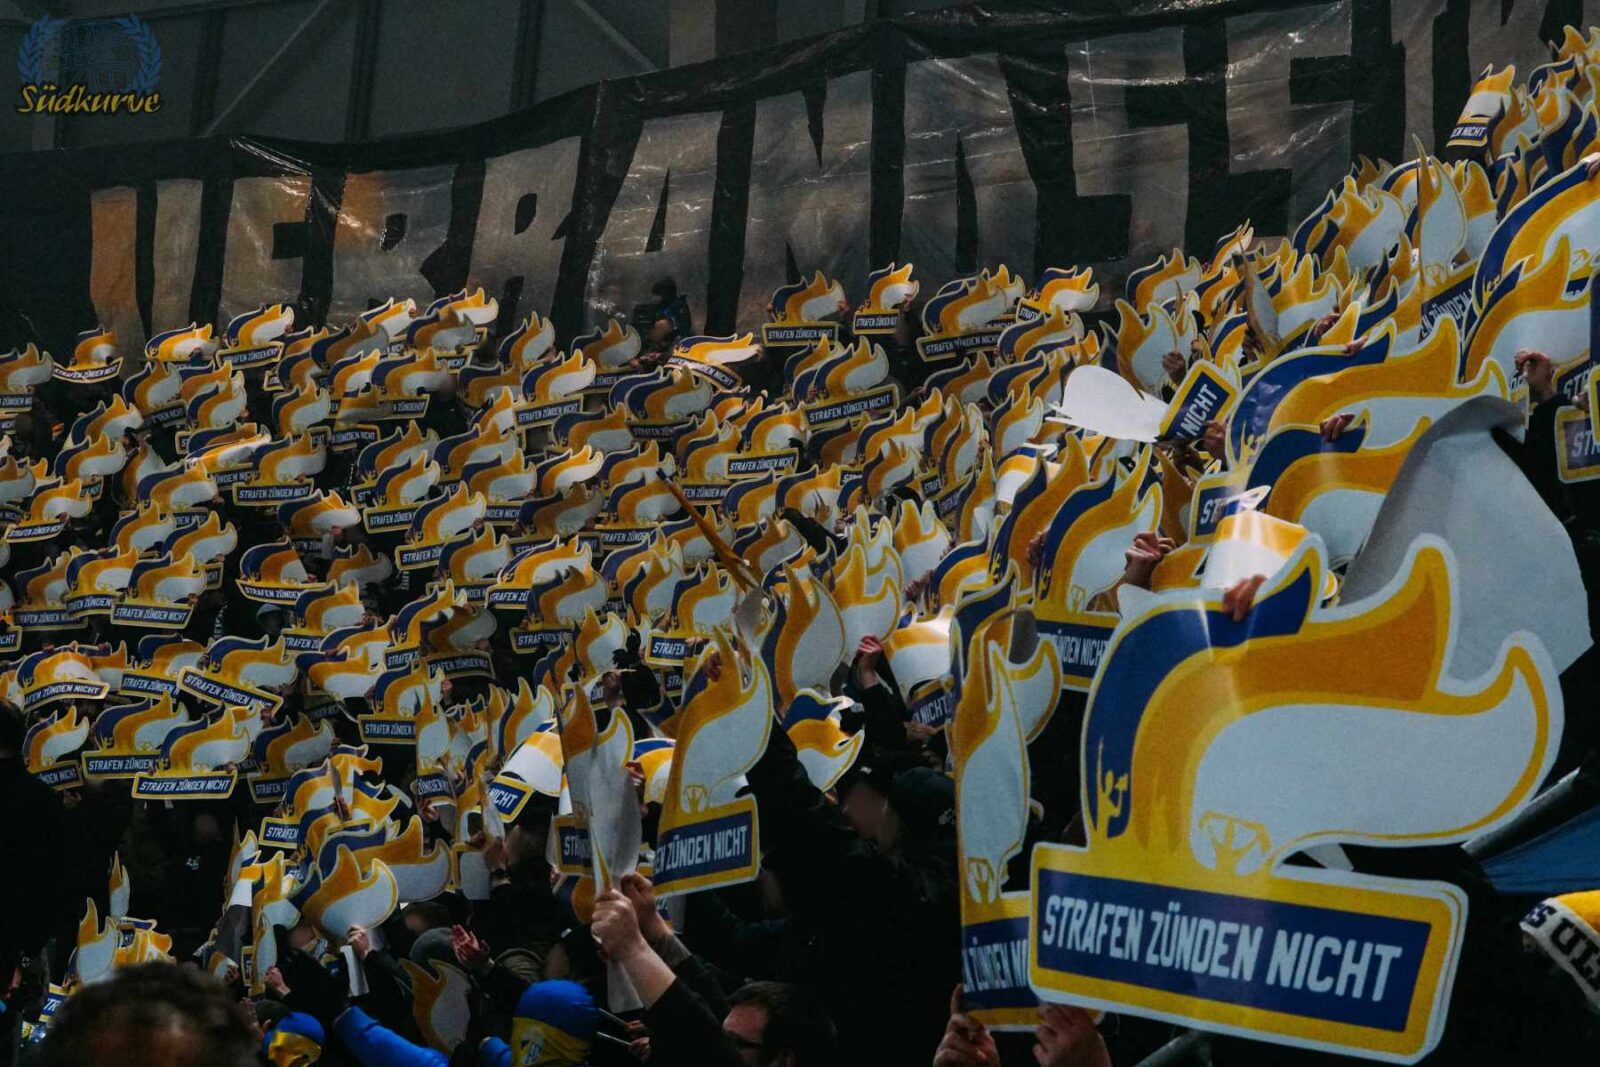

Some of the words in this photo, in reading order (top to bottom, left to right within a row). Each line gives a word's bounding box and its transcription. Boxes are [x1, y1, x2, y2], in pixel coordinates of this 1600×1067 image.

[1466, 126, 1488, 138] NICHT
[768, 329, 793, 341] STRAFEN
[810, 408, 841, 422] STRAFEN
[843, 401, 868, 416] ZÜNDEN
[869, 395, 891, 410] NICHT
[1180, 383, 1218, 437] NICHT
[730, 462, 755, 472] STRAFEN
[756, 458, 777, 469] ZÜNDEN
[240, 489, 267, 499] STRAFEN
[268, 486, 293, 498] ZÜNDEN
[403, 549, 431, 563] STRAFEN
[244, 586, 273, 598] STRAFEN
[115, 606, 142, 618] STRAFEN
[143, 607, 167, 620] ZÜNDEN
[168, 610, 188, 621] NICHT
[652, 641, 685, 656] STRAFEN
[123, 677, 147, 688] STRAFEN
[43, 684, 73, 698] ZÜNDEN
[75, 683, 100, 695] NICHT
[185, 674, 219, 695] STRAFEN
[220, 688, 249, 708] ZÜNDEN
[919, 697, 948, 726] NICHT
[365, 722, 390, 735] STRAFEN
[89, 759, 124, 772] STRAFEN
[125, 757, 155, 771] ZÜNDEN
[140, 781, 175, 792] STRAFEN
[176, 778, 205, 792] ZÜNDEN
[206, 779, 230, 792] NICHT
[489, 787, 518, 809] NICHT
[266, 826, 298, 839] STRAFEN
[666, 834, 712, 870] ZÜNDEN
[714, 826, 748, 863] NICHT
[1041, 894, 1146, 966] STRAFEN
[1147, 901, 1264, 982] ZÜNDEN
[1266, 929, 1403, 1003] NICHT
